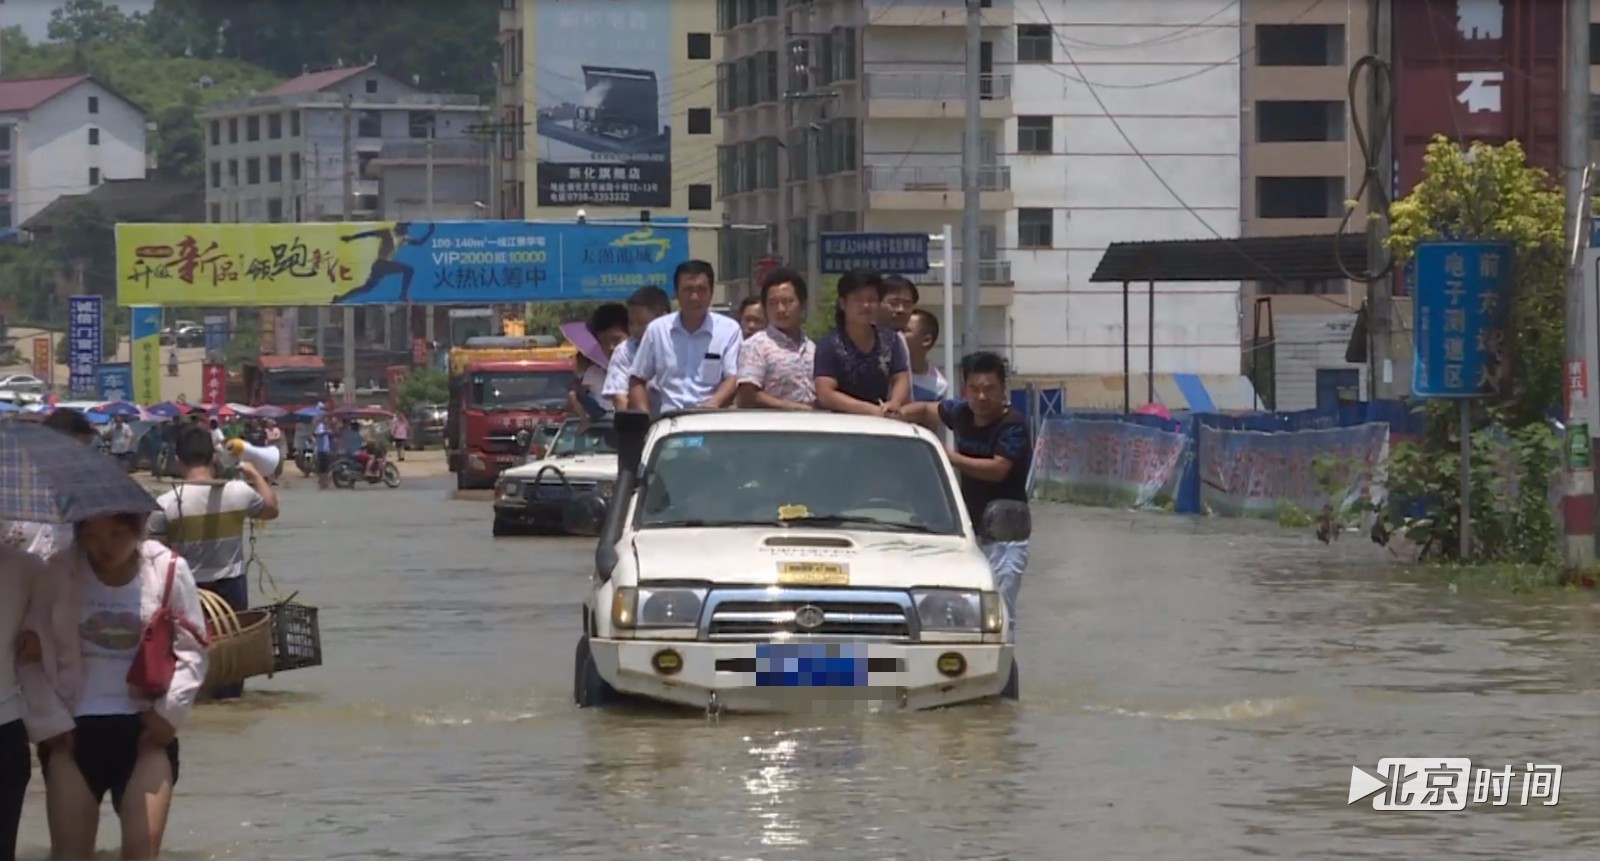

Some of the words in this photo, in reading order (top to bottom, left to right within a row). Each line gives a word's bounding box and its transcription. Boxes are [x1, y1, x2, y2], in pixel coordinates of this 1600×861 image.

[1443, 252, 1467, 389] 电子测速区
